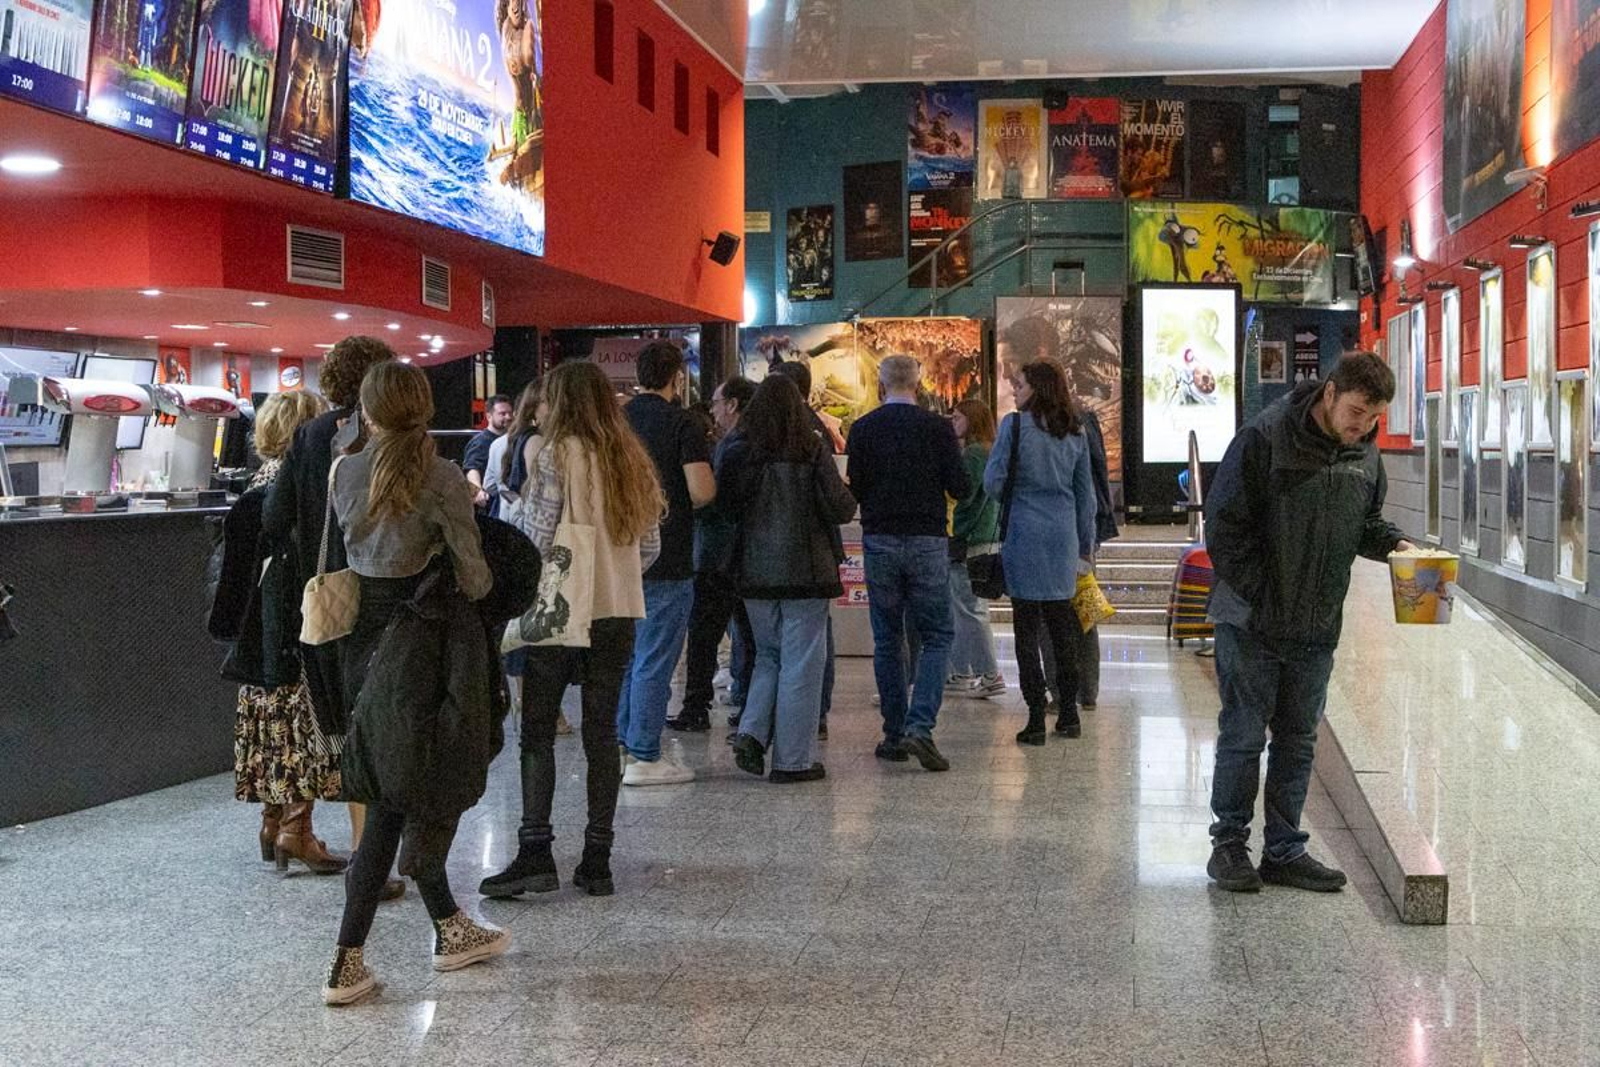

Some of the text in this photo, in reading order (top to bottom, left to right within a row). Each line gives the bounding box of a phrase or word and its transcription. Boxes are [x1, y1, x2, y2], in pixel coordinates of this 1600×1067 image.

[477, 32, 496, 93] 2
[12, 74, 34, 91] 17:00
[200, 30, 270, 121] WICKED
[1155, 99, 1185, 113] VIVIR
[1171, 112, 1185, 125] EL
[985, 125, 1027, 138] MICKEY
[1123, 123, 1185, 137] MOMENTO
[1052, 131, 1117, 148] ANATEMA
[910, 214, 973, 231] MONKEY
[597, 352, 611, 363] LA
